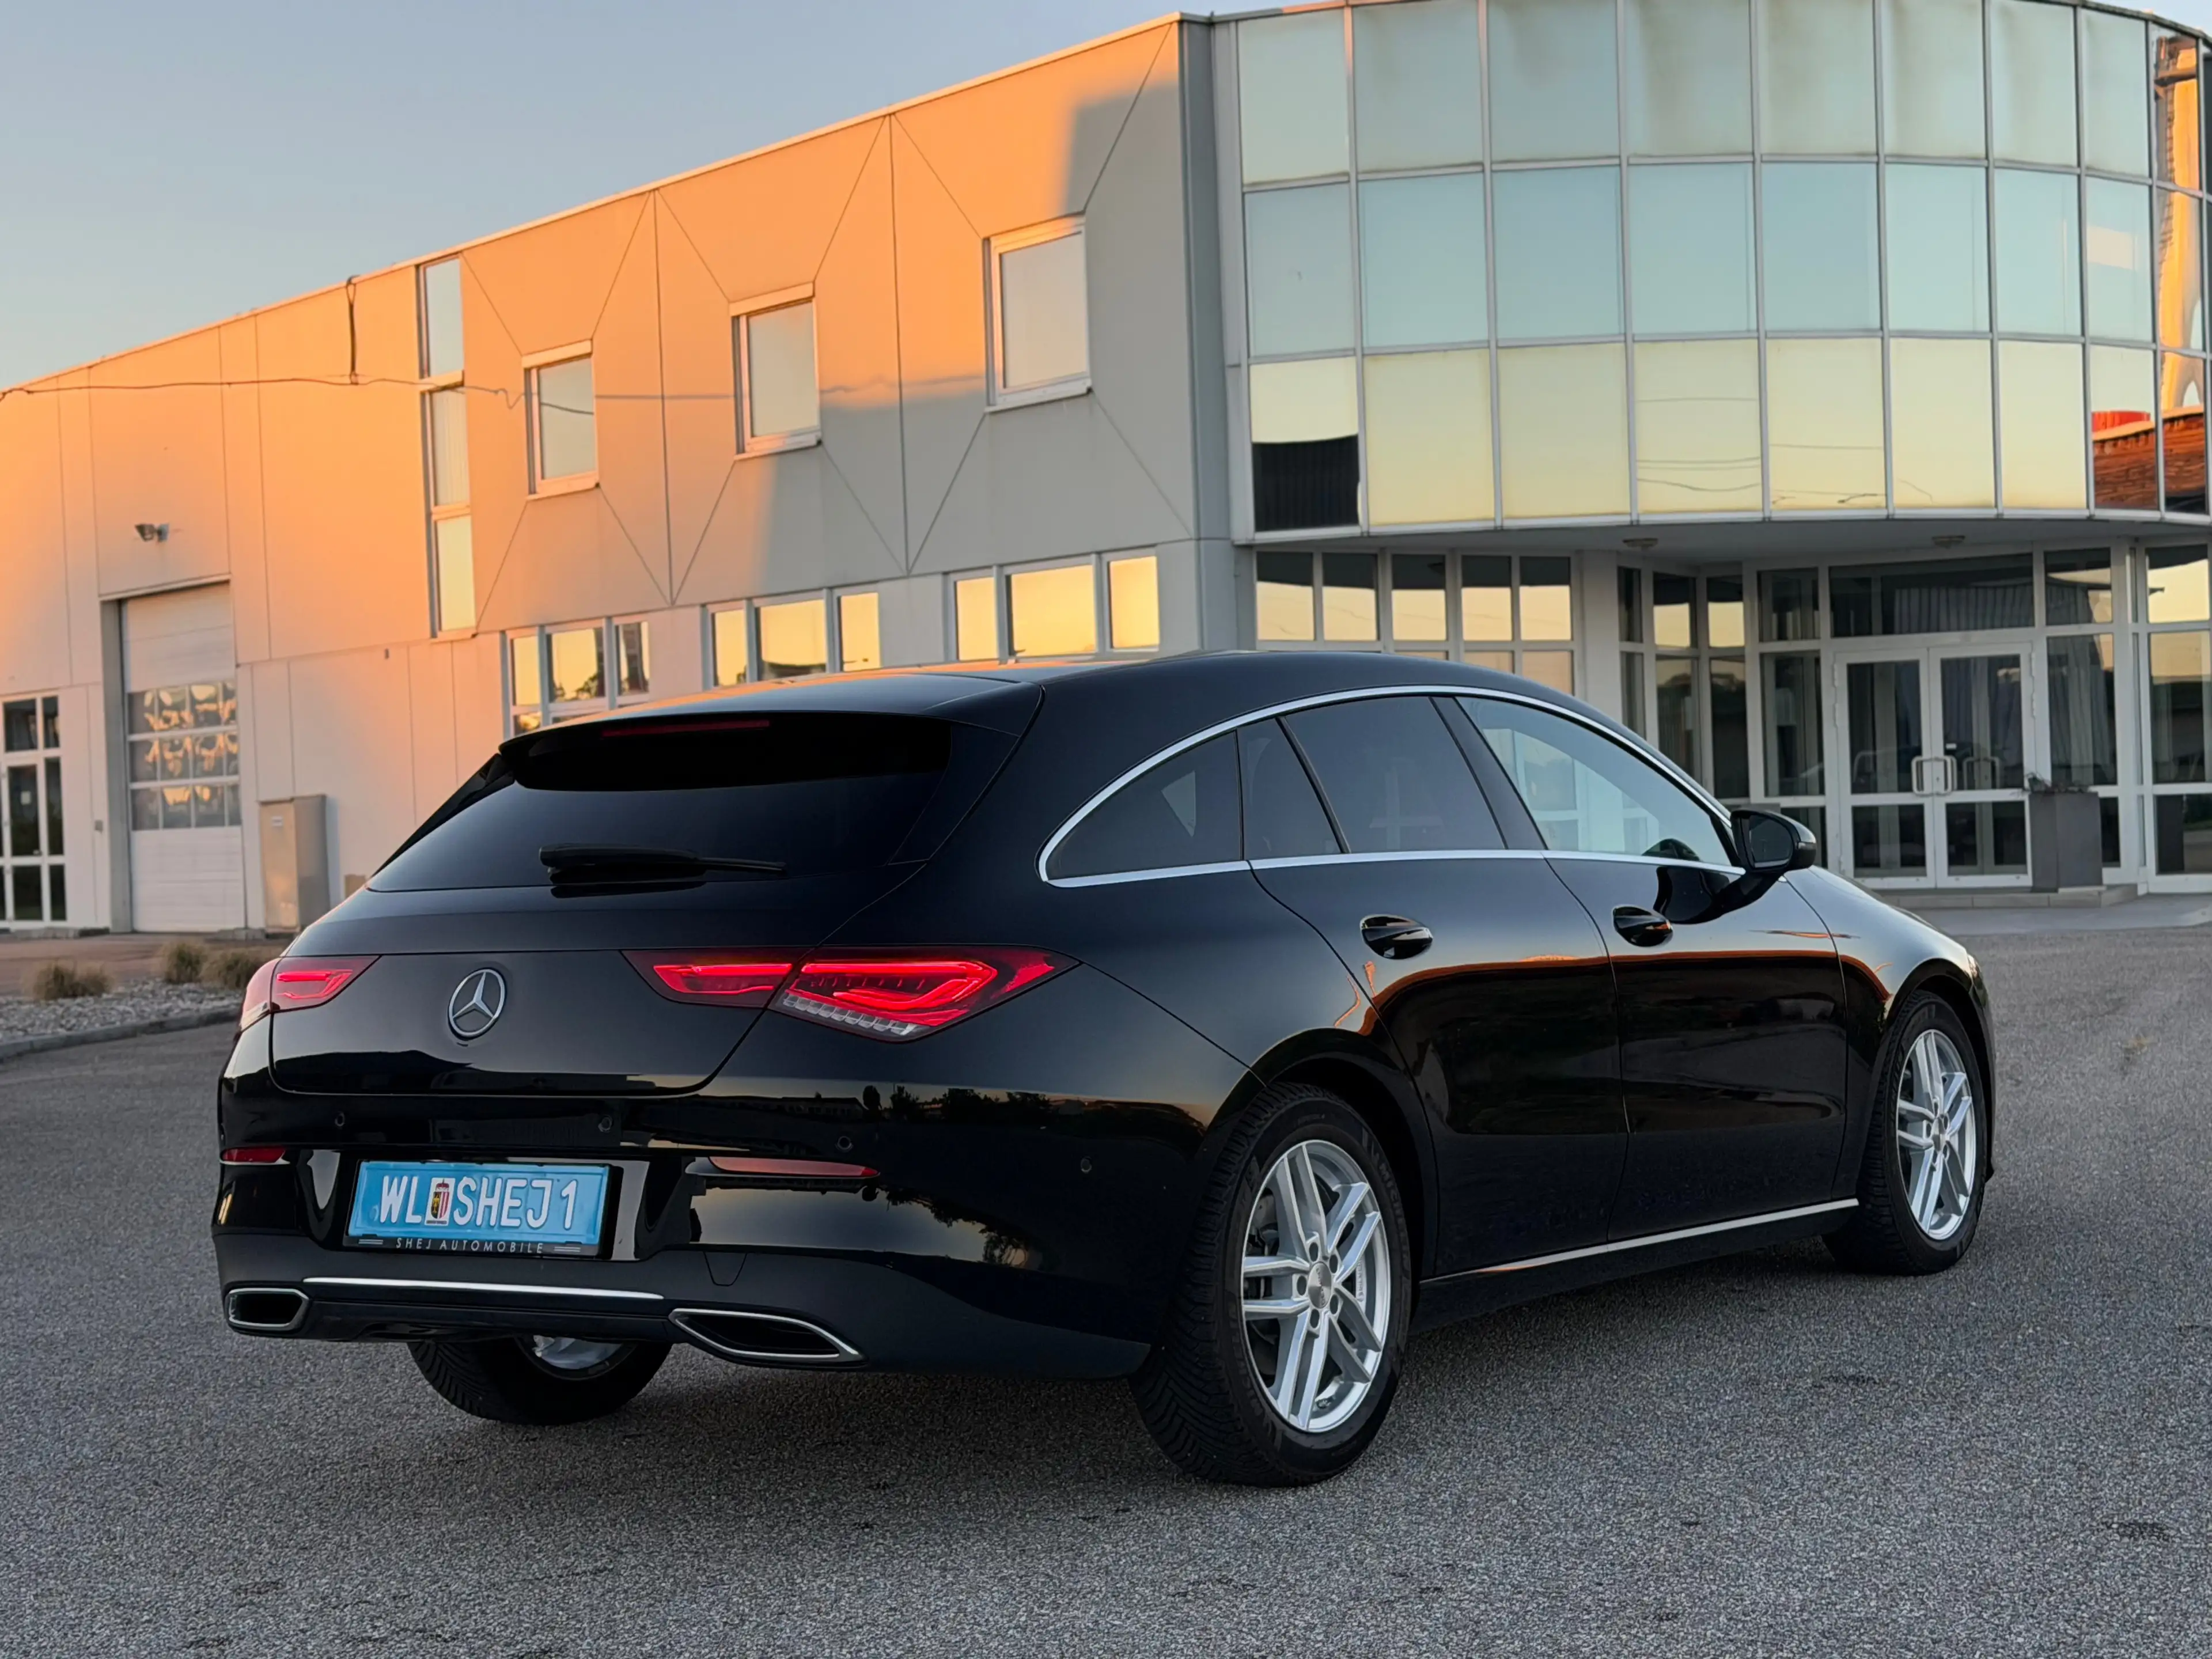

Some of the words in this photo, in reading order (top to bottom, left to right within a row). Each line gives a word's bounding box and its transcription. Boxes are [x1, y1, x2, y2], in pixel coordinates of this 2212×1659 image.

[379, 1175, 422, 1224] WL
[453, 1176, 554, 1229] SHEJ
[560, 1179, 578, 1230] 1
[396, 1237, 432, 1250] SHEJ
[440, 1240, 544, 1254] AUTOMOBILE
